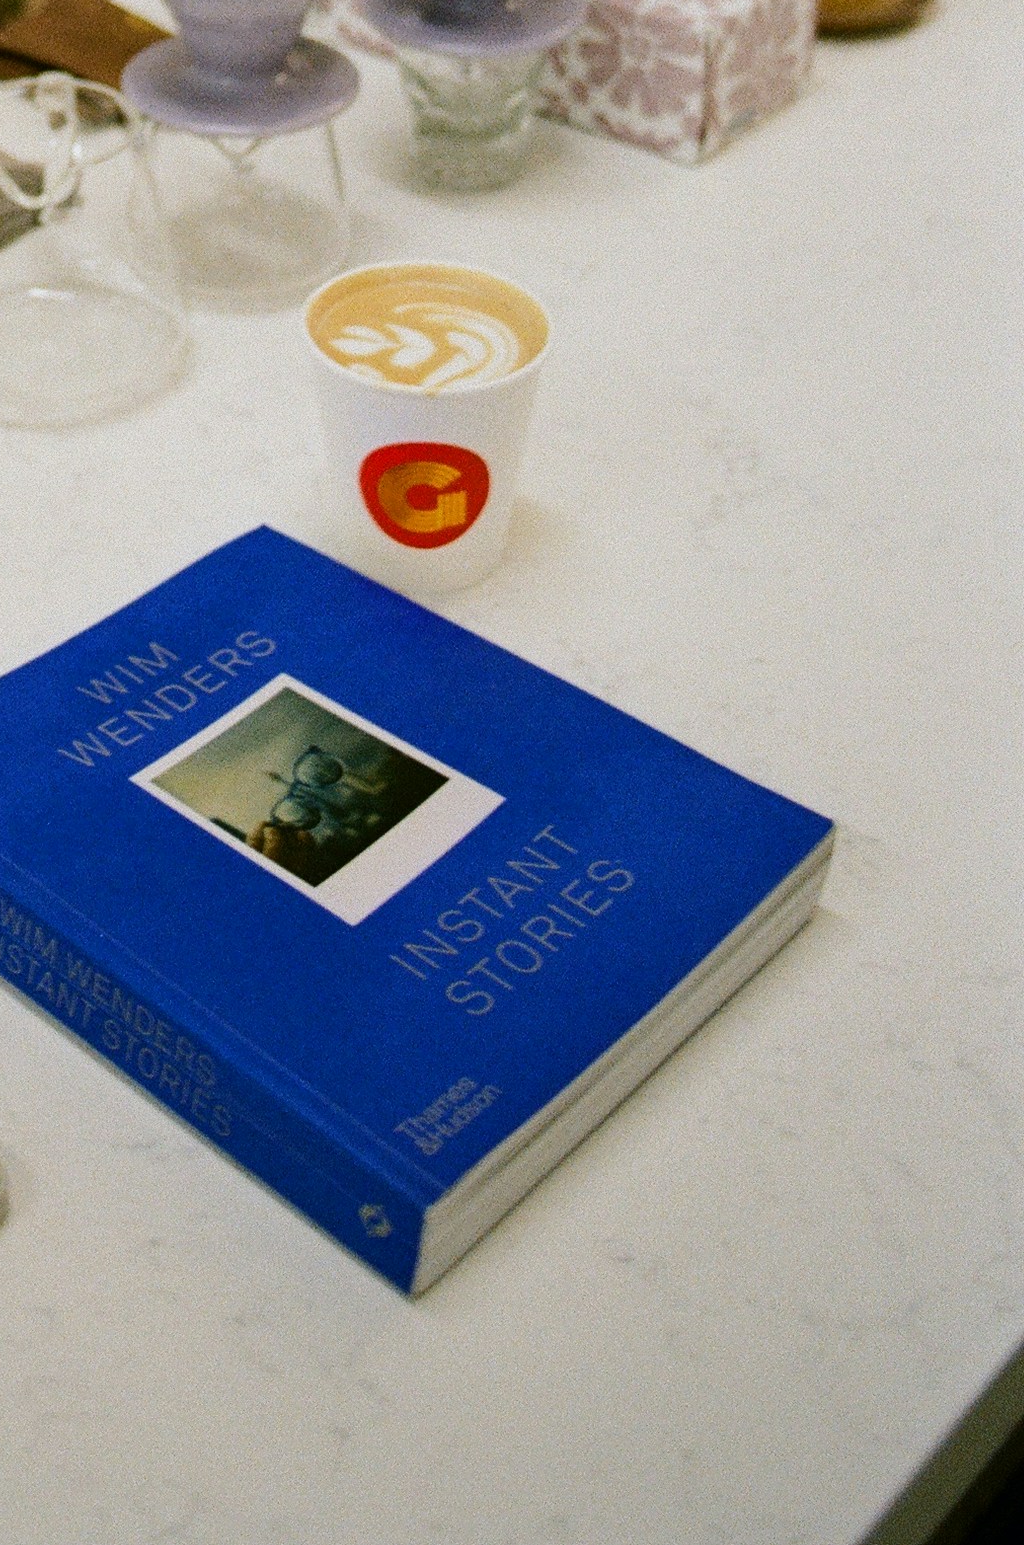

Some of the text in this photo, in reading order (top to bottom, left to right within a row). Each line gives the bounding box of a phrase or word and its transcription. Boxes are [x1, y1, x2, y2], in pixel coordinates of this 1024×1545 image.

[57, 630, 277, 767] WENDERS
[77, 641, 180, 705] WIM
[389, 824, 578, 981] INSTANT
[445, 859, 636, 1016] STORIES
[0, 897, 217, 1087] WIM WENDERS
[102, 1019, 232, 1138] STORIES
[393, 1077, 476, 1141] Thames
